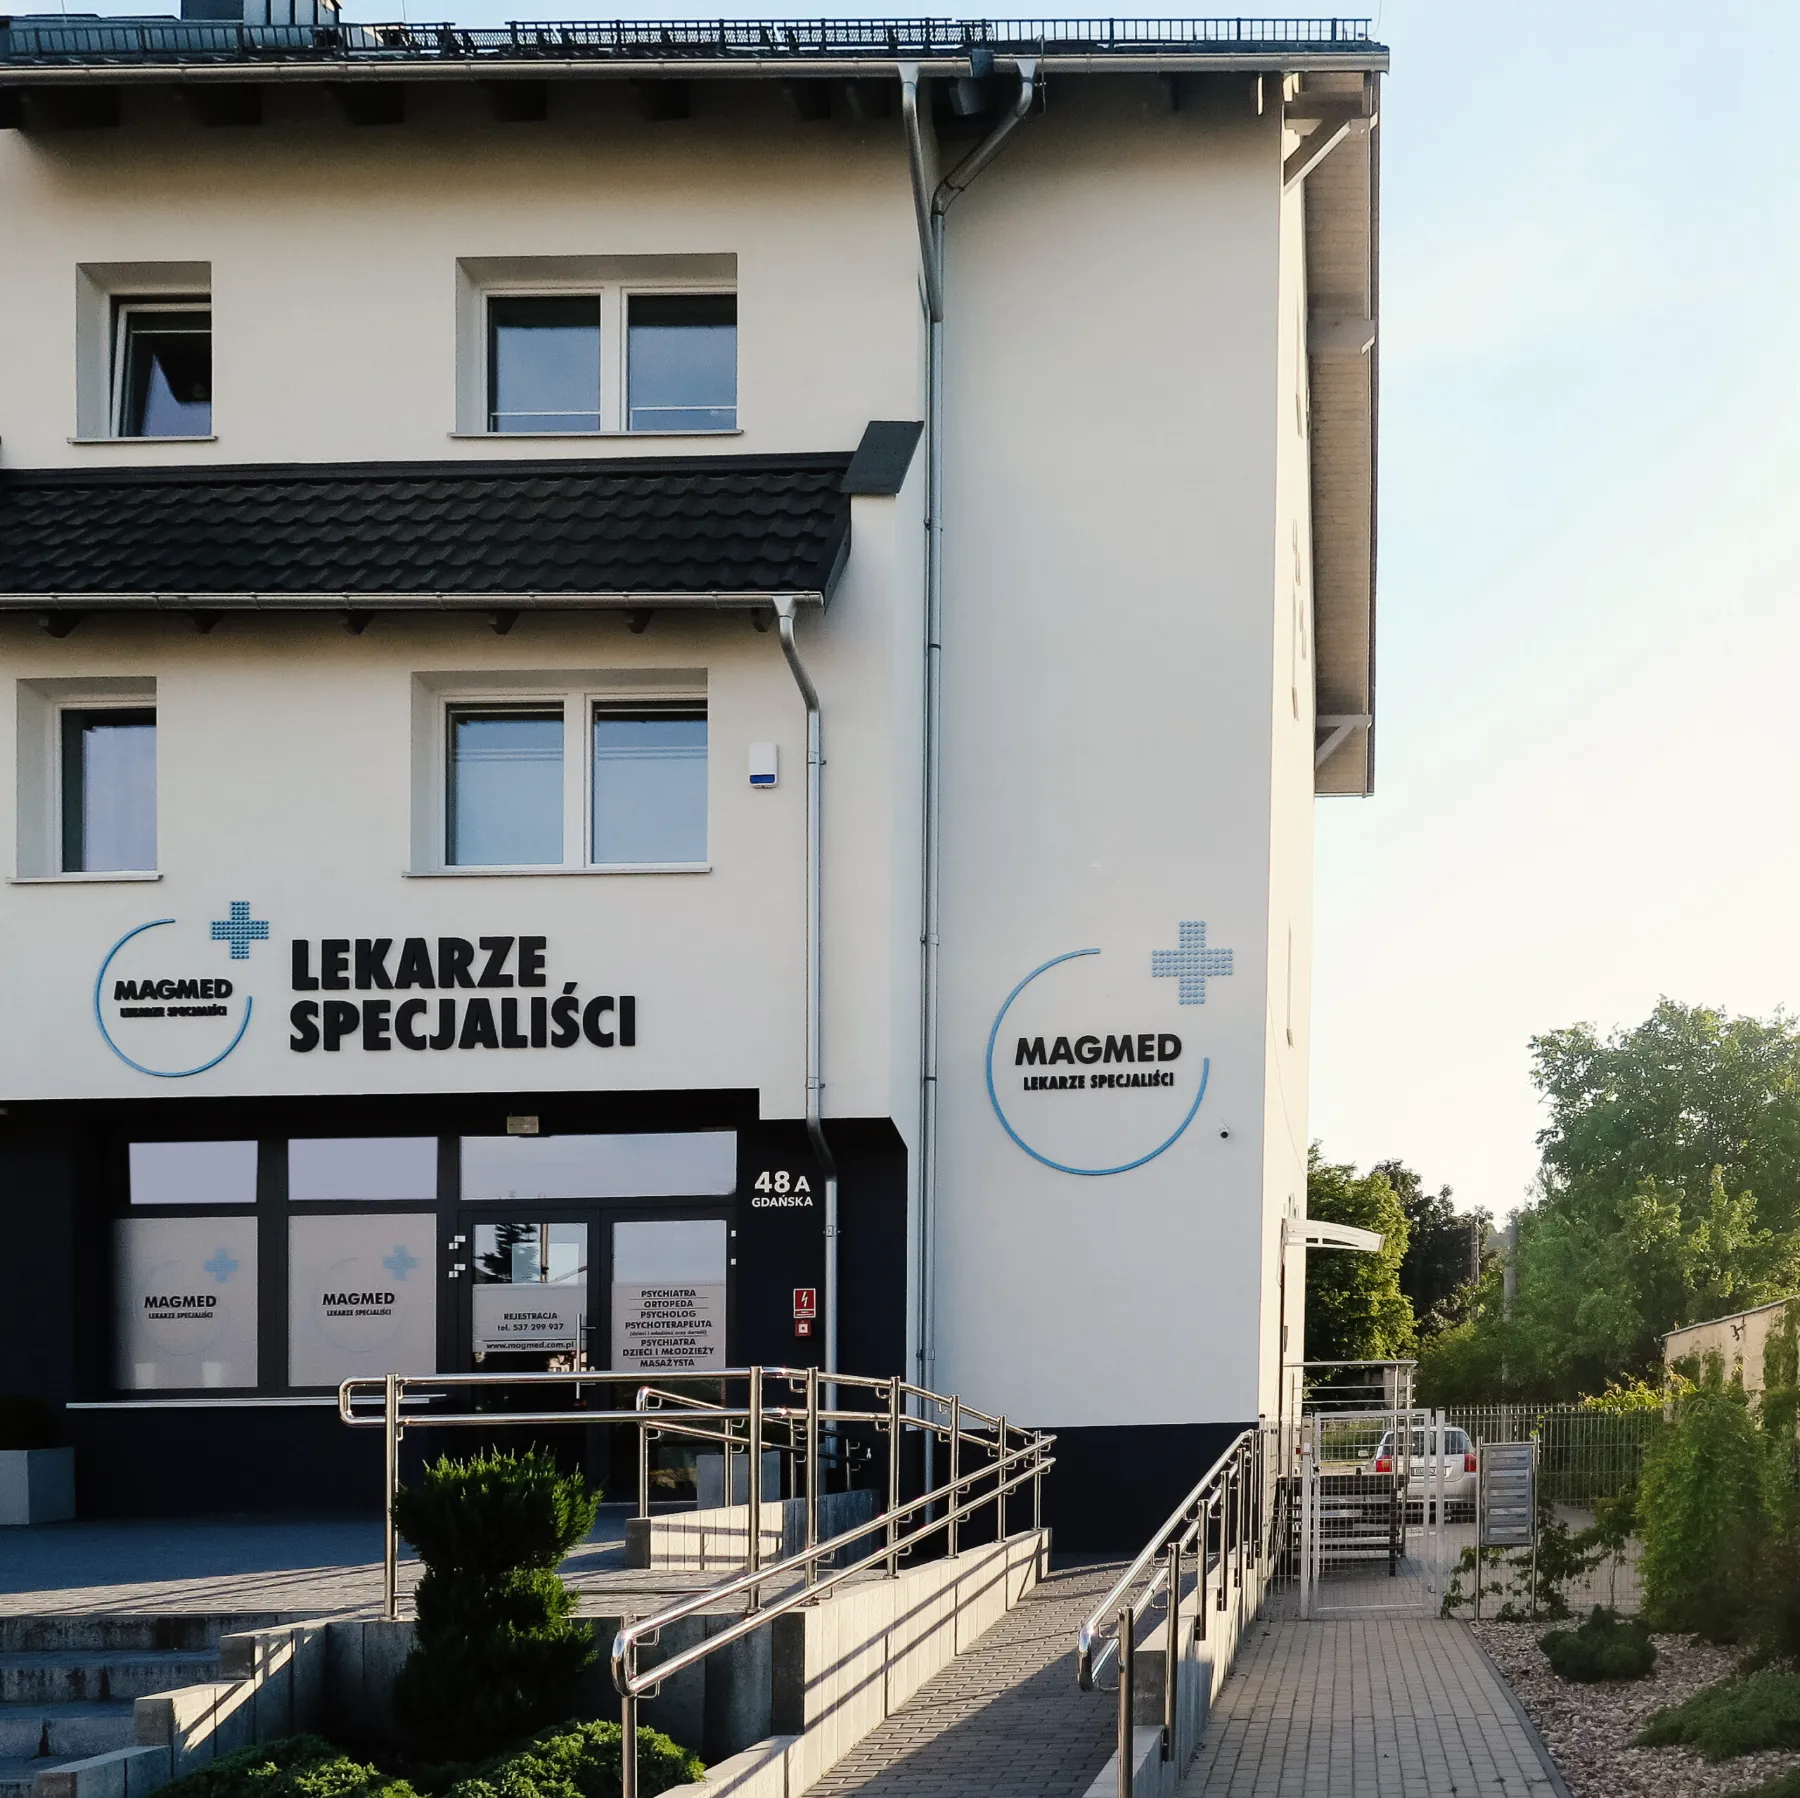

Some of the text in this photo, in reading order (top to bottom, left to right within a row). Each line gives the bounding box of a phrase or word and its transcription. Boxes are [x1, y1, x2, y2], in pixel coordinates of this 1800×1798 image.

[291, 935, 547, 991] LEKARZE
[114, 978, 233, 1000] MAGMED
[289, 981, 636, 1053] SPECJALIŚCI
[1014, 1033, 1182, 1066] MAGMED
[1023, 1075, 1085, 1091] LEKARZE
[1090, 1069, 1175, 1089] SPECJALIŚCI
[751, 1194, 814, 1208] GDAŃSKA
[322, 1292, 396, 1306] MAGMED
[641, 1289, 697, 1298] PSYCHIATRA
[143, 1295, 217, 1309] MAGMED
[643, 1299, 694, 1308] ORTOPEDA
[326, 1309, 353, 1317] LEKARZE
[503, 1312, 558, 1321] REJESTRACJA
[640, 1310, 697, 1319] PSYCHOLOG
[497, 1322, 564, 1332] tel. 537 299 937
[625, 1320, 713, 1330] PSYCHOTERAPEUTA
[486, 1340, 575, 1350] www.magmed.com.pl
[640, 1338, 697, 1347] PSYCHIATRA
[622, 1348, 653, 1357] DZIECI
[661, 1345, 715, 1356] MŁODZIEŻY
[640, 1358, 695, 1368] MASAŻYSTA
